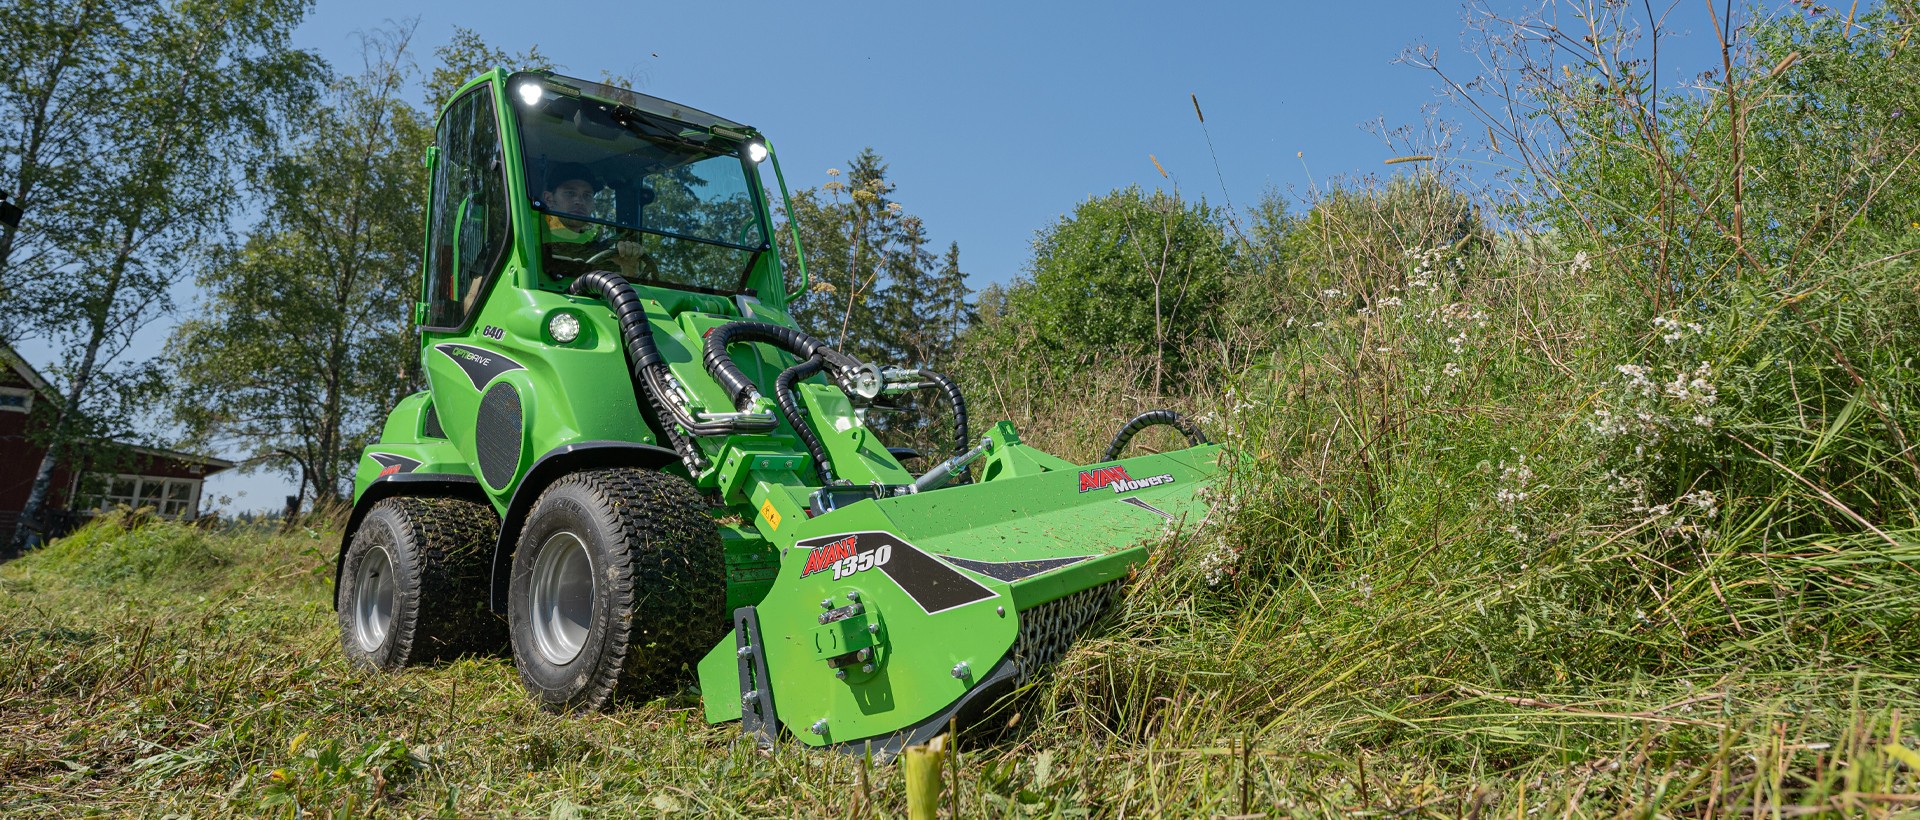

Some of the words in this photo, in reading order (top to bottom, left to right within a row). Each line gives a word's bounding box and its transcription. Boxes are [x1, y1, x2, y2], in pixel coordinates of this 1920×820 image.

[452, 347, 492, 366] OPTIDRIVE
[1079, 465, 1133, 493] AVANT
[1111, 474, 1175, 494] Mowers
[801, 535, 858, 578] AVANT
[832, 544, 892, 581] 1350
